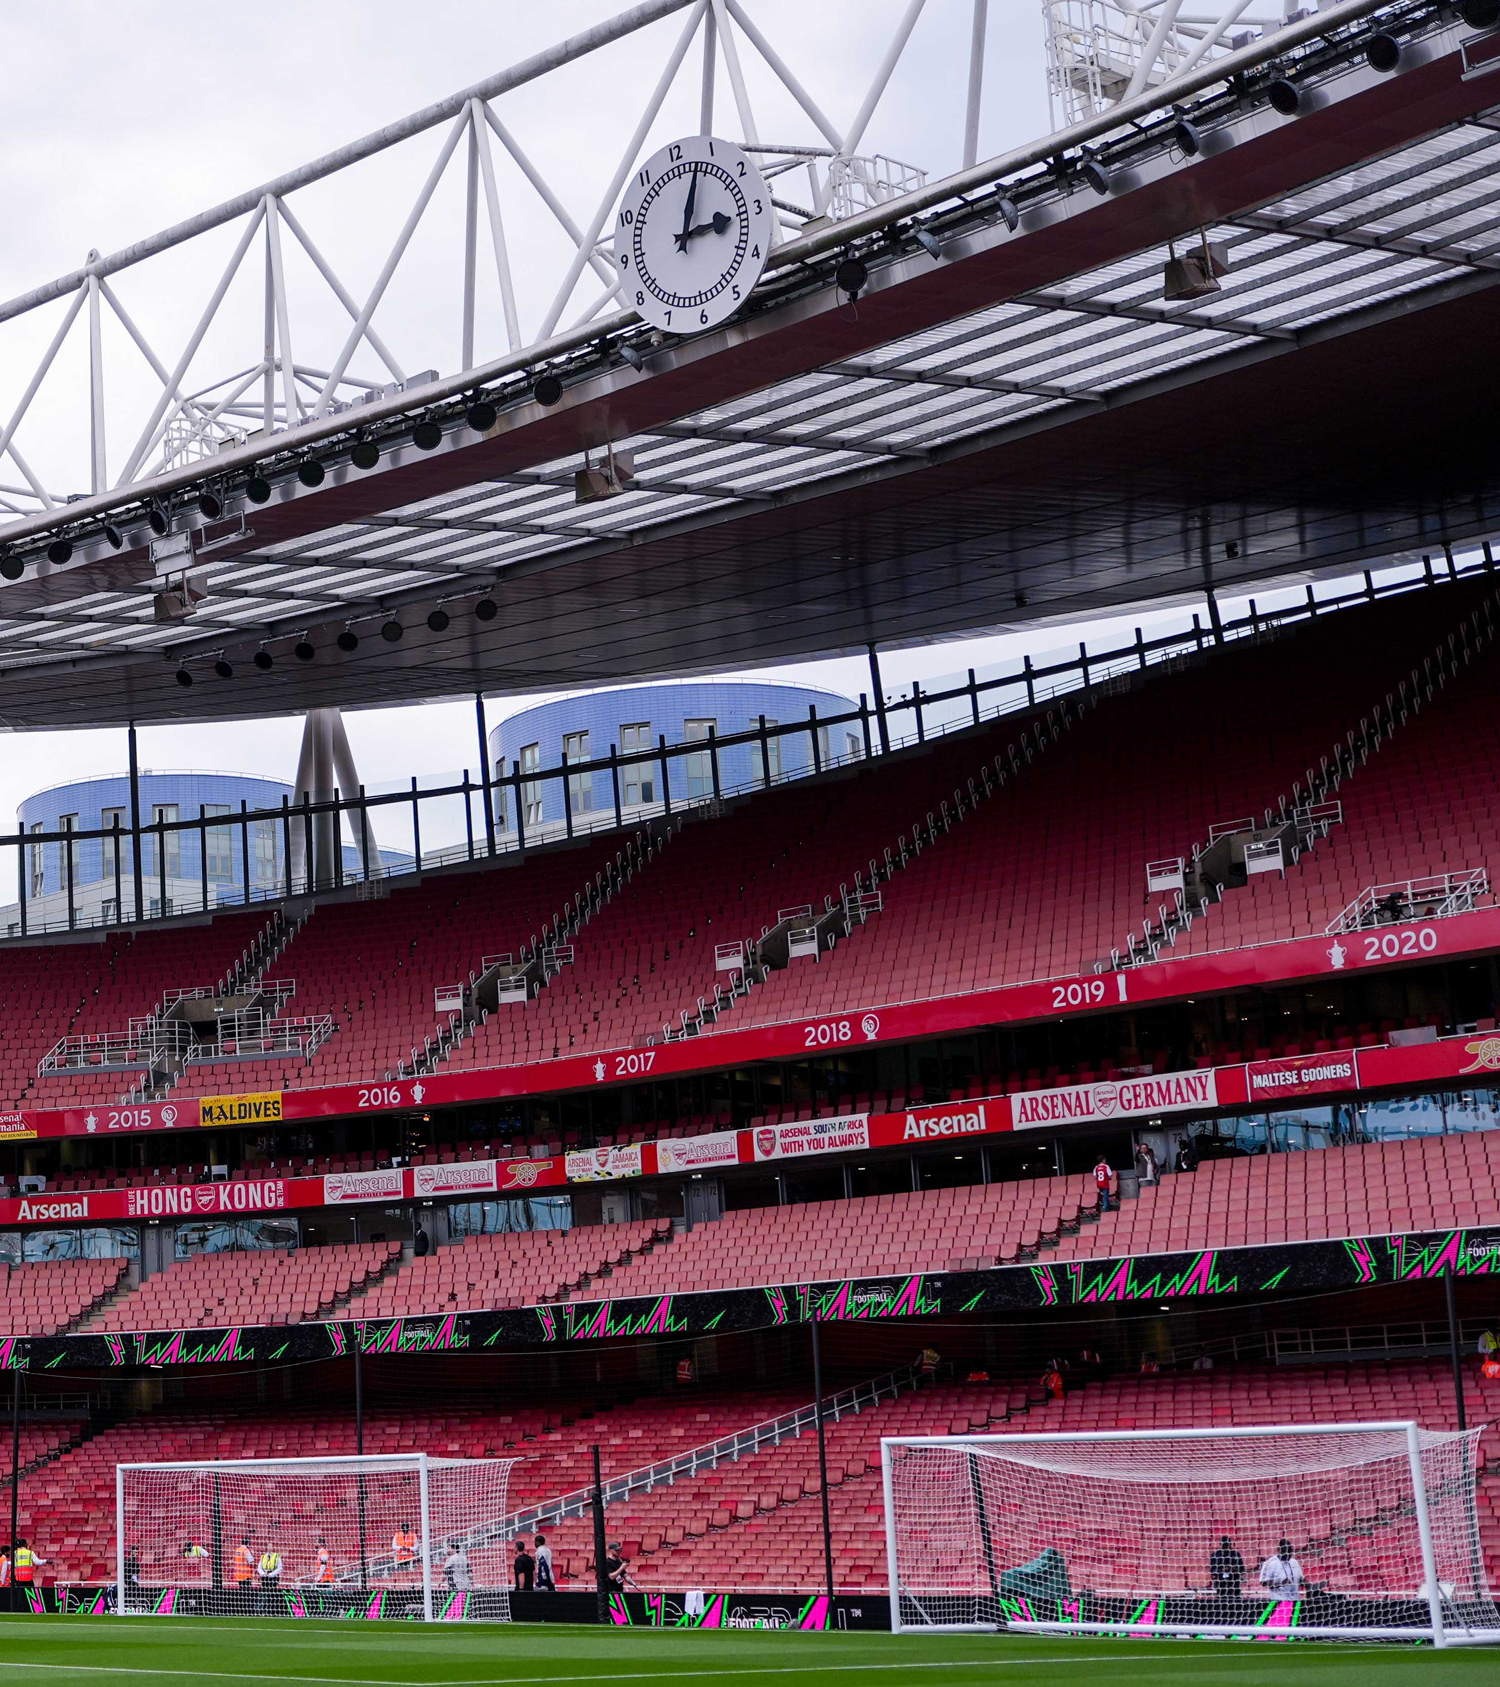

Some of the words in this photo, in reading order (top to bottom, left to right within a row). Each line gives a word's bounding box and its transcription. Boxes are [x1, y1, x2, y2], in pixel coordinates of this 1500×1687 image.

[668, 145, 683, 163] 12
[709, 142, 714, 156] 1
[639, 170, 651, 187] 11
[736, 161, 747, 178] 2
[753, 199, 763, 215] 3
[620, 209, 633, 227] 10
[751, 244, 761, 260] 4
[620, 254, 629, 270] 9
[636, 291, 645, 306] 8
[732, 284, 741, 301] 5
[664, 311, 672, 326] 7
[700, 309, 708, 324] 6
[1364, 928, 1438, 960] 2020
[1052, 980, 1105, 1008] 2019
[804, 1021, 852, 1047] 2018
[615, 1051, 655, 1075] 2017
[1253, 1070, 1299, 1089] MALTESE
[1301, 1063, 1352, 1083] GOONERS
[358, 1085, 401, 1107] 2016
[1018, 1090, 1095, 1124] ARSENAL
[1118, 1074, 1209, 1112] GERMANY
[108, 1109, 152, 1129] 2015
[202, 1100, 281, 1124] MALDIVES
[780, 1126, 812, 1139] ARSENAL
[813, 1122, 837, 1135] SOUTH
[838, 1119, 864, 1132] AFRICA
[903, 1105, 987, 1140] Arsenal
[687, 1137, 736, 1159] Arsenal
[781, 1141, 804, 1154] WITH
[805, 1137, 825, 1151] YOU
[827, 1132, 866, 1148] ALWAYS
[568, 1156, 593, 1168] ARSENAL
[611, 1151, 639, 1164] JAMAICA
[343, 1171, 402, 1193] Arsenal
[436, 1163, 493, 1185] Arsenal
[1097, 1170, 1105, 1181] 8
[276, 1180, 284, 1197] TEAM
[136, 1187, 192, 1215] HONG
[219, 1182, 276, 1211] KONG
[17, 1197, 89, 1221] Arsenal
[128, 1204, 136, 1216] ONE
[164, 1230, 172, 1239] 70
